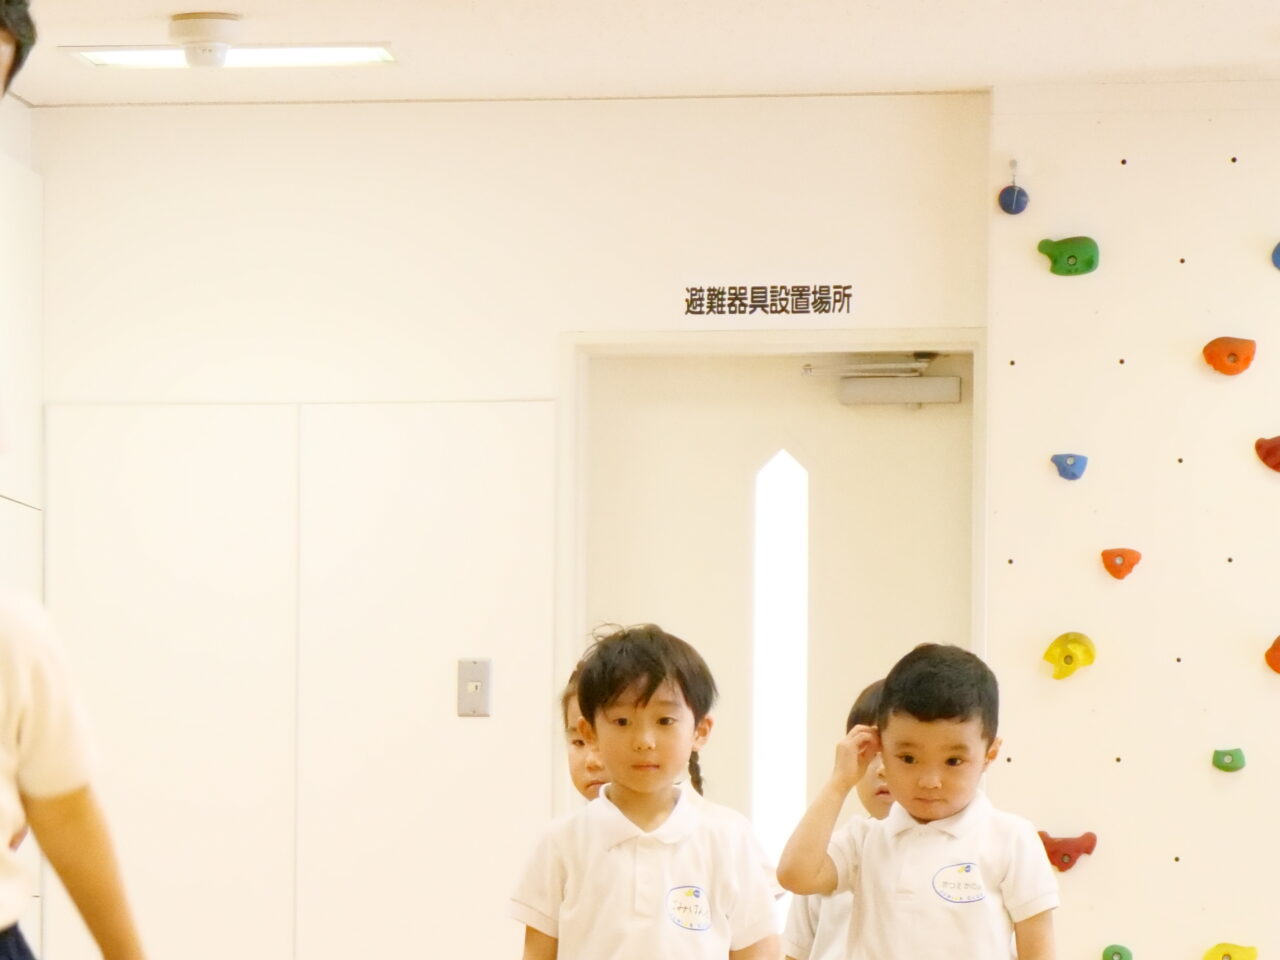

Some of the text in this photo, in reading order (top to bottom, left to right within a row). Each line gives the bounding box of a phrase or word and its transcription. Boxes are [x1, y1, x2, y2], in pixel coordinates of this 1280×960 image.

[685, 285, 852, 315] 避難器具設置場所
